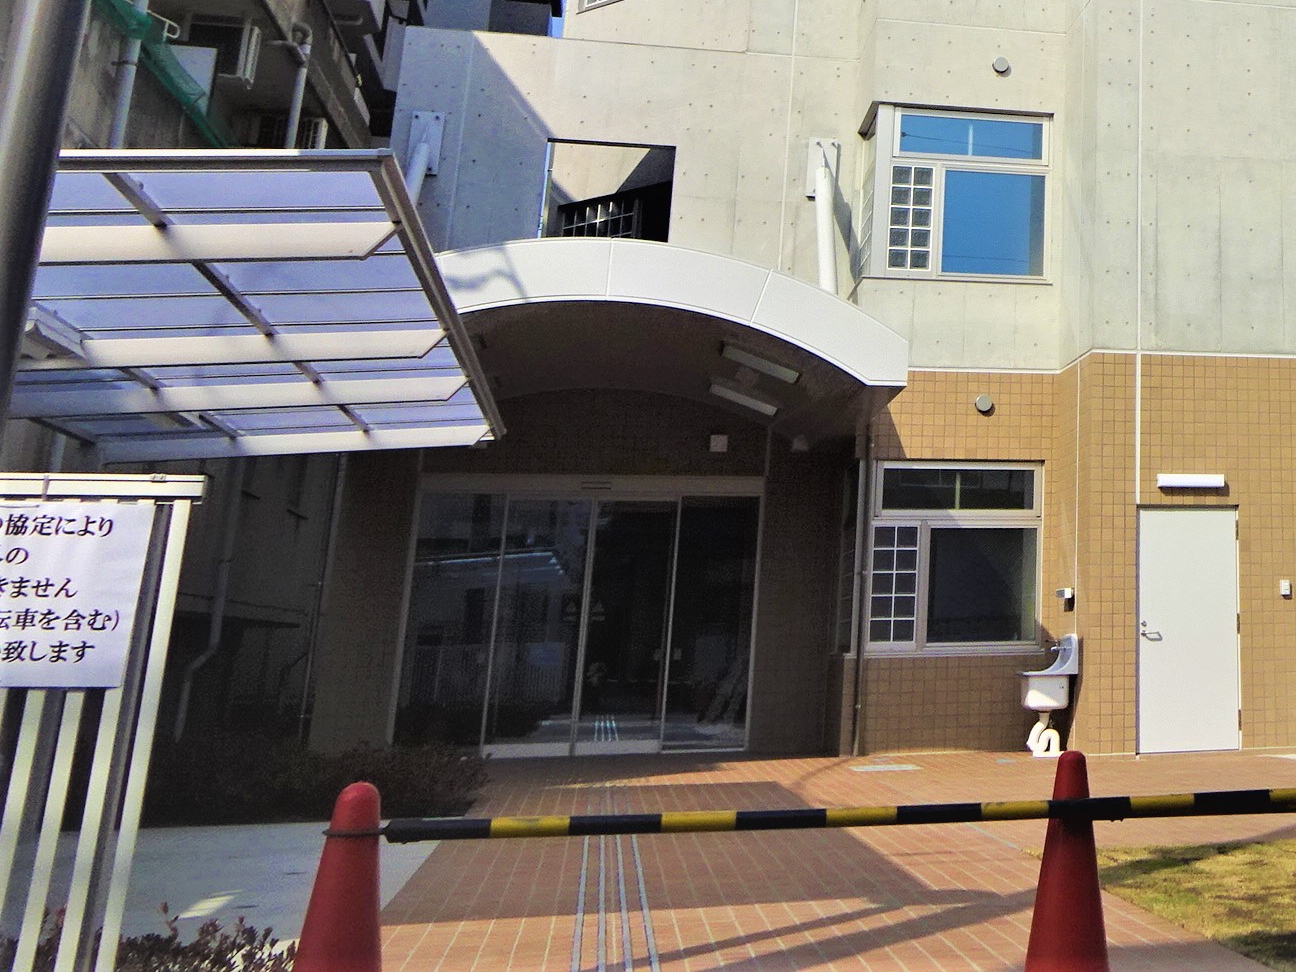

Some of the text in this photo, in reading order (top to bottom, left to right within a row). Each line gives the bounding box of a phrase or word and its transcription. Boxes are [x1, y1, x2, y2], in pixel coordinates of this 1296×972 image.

[0, 514, 114, 537] 協定により
[0, 547, 29, 565] の
[0, 640, 95, 663] 致します
